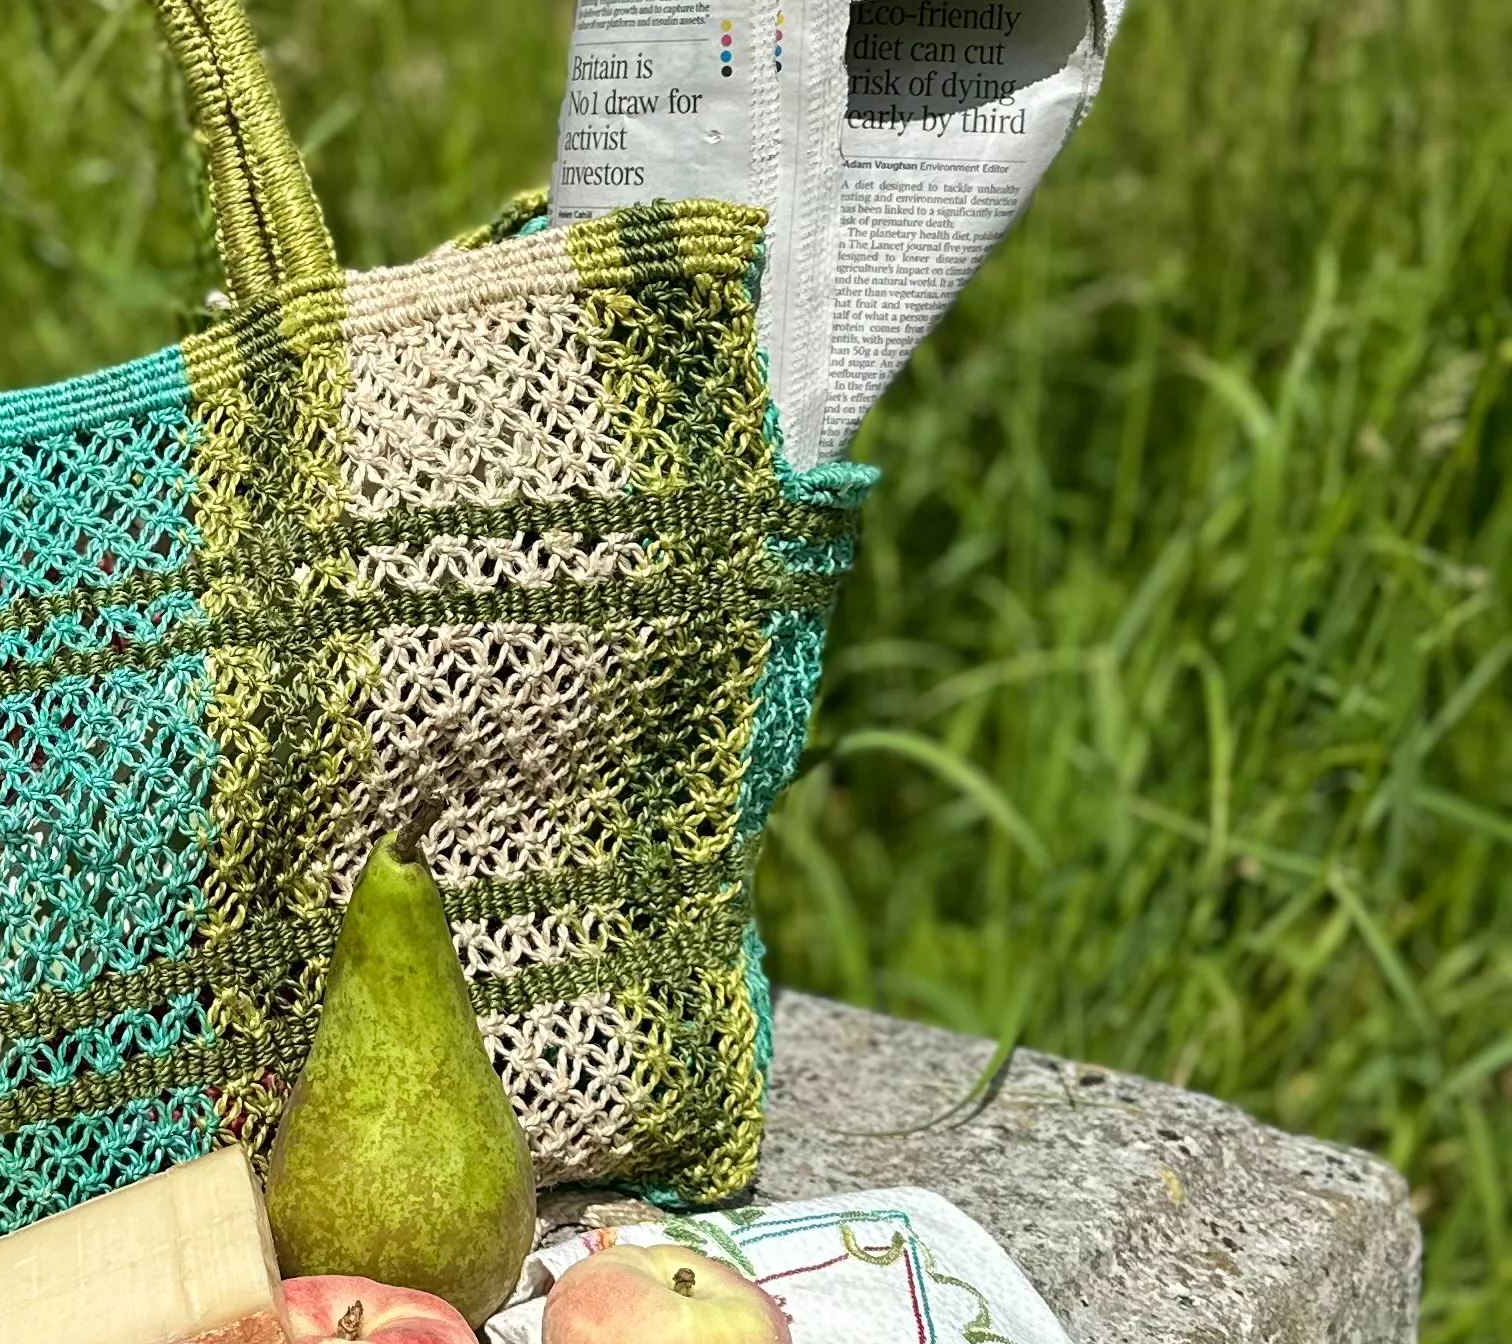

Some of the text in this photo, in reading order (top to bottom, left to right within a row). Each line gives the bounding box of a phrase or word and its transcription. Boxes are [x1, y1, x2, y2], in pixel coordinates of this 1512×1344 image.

[639, 5, 653, 14] and
[654, 3, 663, 13] to
[663, 4, 695, 16] capture
[696, 3, 710, 11] the
[637, 16, 650, 26] and
[857, 1, 1022, 36] Eco-friendly
[853, 34, 1005, 65] diet can cut
[571, 52, 653, 81] Britain is
[850, 69, 1017, 105] risk of dying
[568, 88, 703, 116] No1 draw for
[847, 105, 1025, 137] early by third
[564, 124, 627, 150] activist
[562, 160, 644, 185] investors
[842, 160, 1009, 173] Adam Vaughan Environment Editor
[841, 180, 849, 189] A
[855, 181, 874, 190] diet
[879, 182, 922, 193] designed
[944, 184, 973, 193] tackle
[978, 185, 1020, 195] unhealthy
[840, 194, 870, 203] eating
[874, 194, 892, 202] and
[896, 194, 967, 204] environmental
[858, 205, 882, 213] been
[885, 205, 914, 215] linked
[917, 206, 926, 215] to
[929, 208, 934, 216] a
[937, 208, 992, 218] significantly
[859, 217, 955, 228] of premature death.
[848, 228, 867, 237] The
[870, 230, 917, 241] planetary
[920, 230, 949, 240] health
[849, 241, 870, 249] The
[871, 242, 904, 251] Lancet
[906, 242, 941, 253] journal
[944, 243, 960, 252] five
[886, 254, 895, 262] to
[903, 254, 930, 262] lower
[936, 255, 967, 264] disease
[896, 266, 929, 276] impact
[854, 276, 869, 284] the
[872, 277, 907, 285] natural
[910, 278, 936, 287] world.
[836, 288, 862, 296] ather
[865, 288, 886, 297] than
[834, 298, 900, 309] hat fruit and
[852, 311, 862, 320] of
[865, 312, 889, 321] what
[900, 314, 928, 322] person
[831, 335, 860, 344] entils,
[862, 336, 883, 344] with
[830, 346, 850, 354] han
[853, 346, 870, 357] 50g
[881, 348, 897, 358] day
[829, 369, 877, 380] eefburger
[835, 381, 845, 389] In
[848, 381, 863, 390] the
